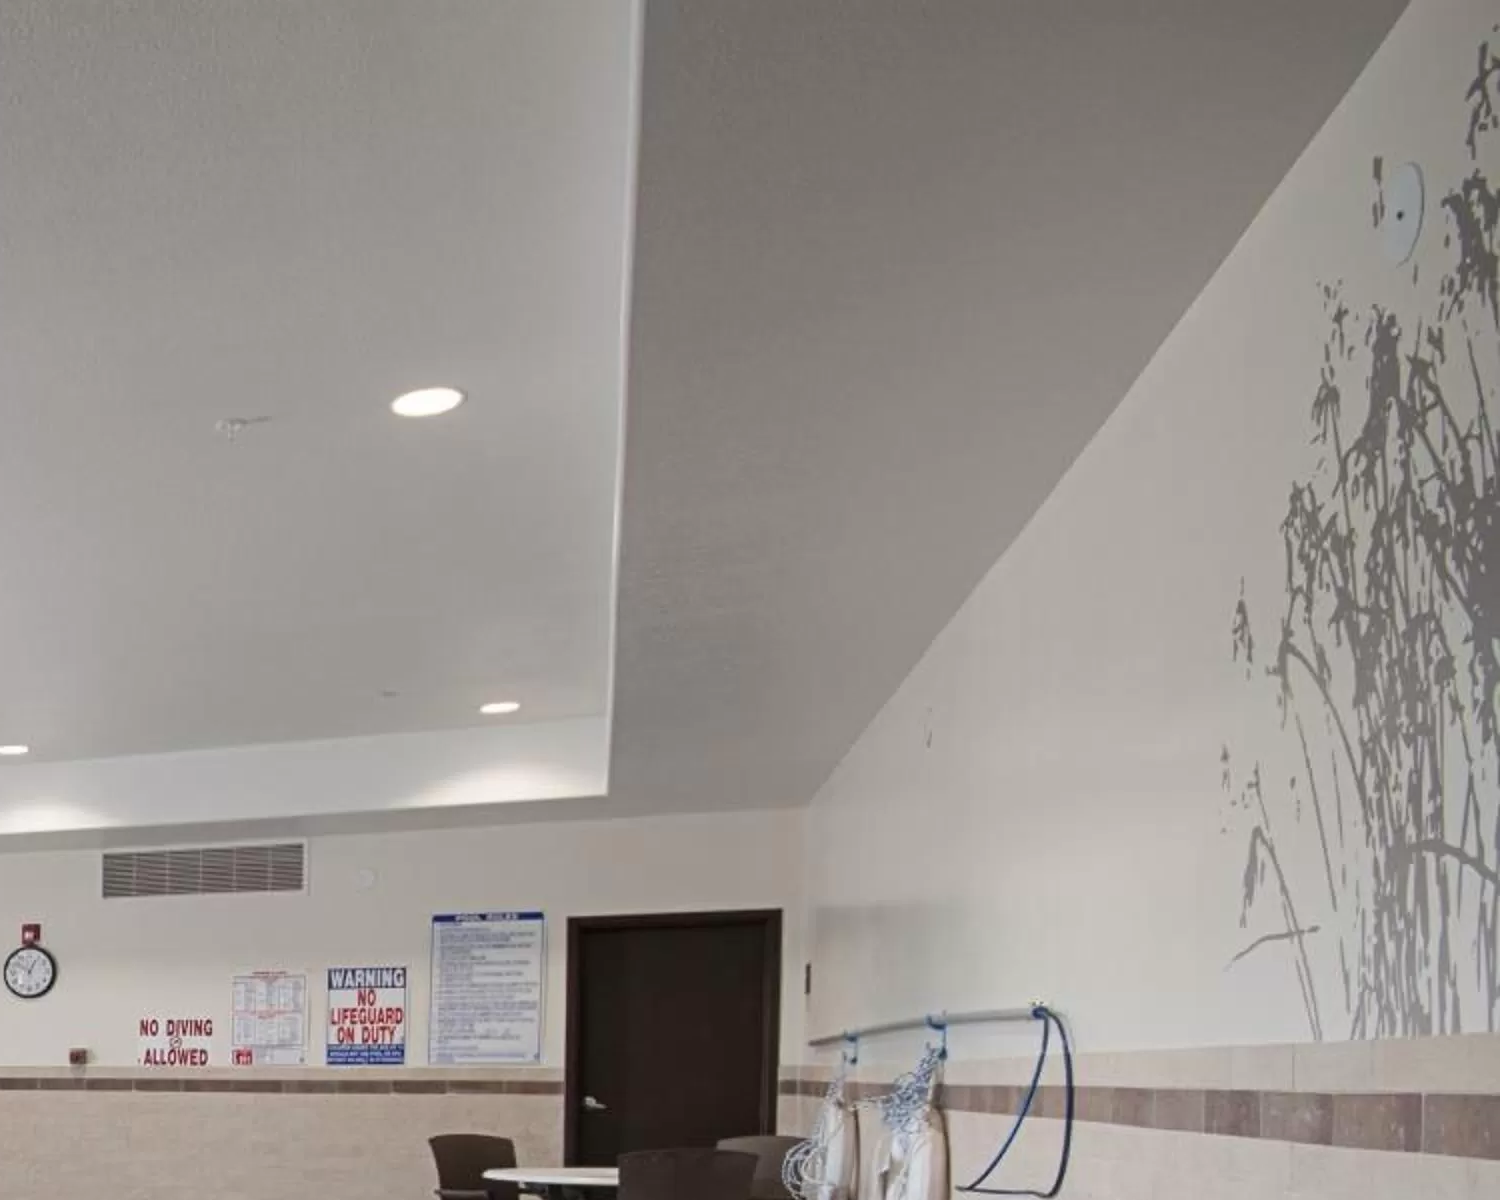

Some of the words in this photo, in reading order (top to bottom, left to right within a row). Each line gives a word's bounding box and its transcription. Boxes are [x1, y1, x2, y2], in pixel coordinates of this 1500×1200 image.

[331, 969, 405, 988] WARNING
[357, 989, 377, 1006] NO
[331, 1007, 404, 1025] LIFEGUARD
[140, 1019, 159, 1036] NO
[166, 1018, 213, 1036] DIVING
[337, 1026, 355, 1043] ON
[361, 1025, 396, 1043] DUTY
[143, 1047, 209, 1066] ALLOWED
